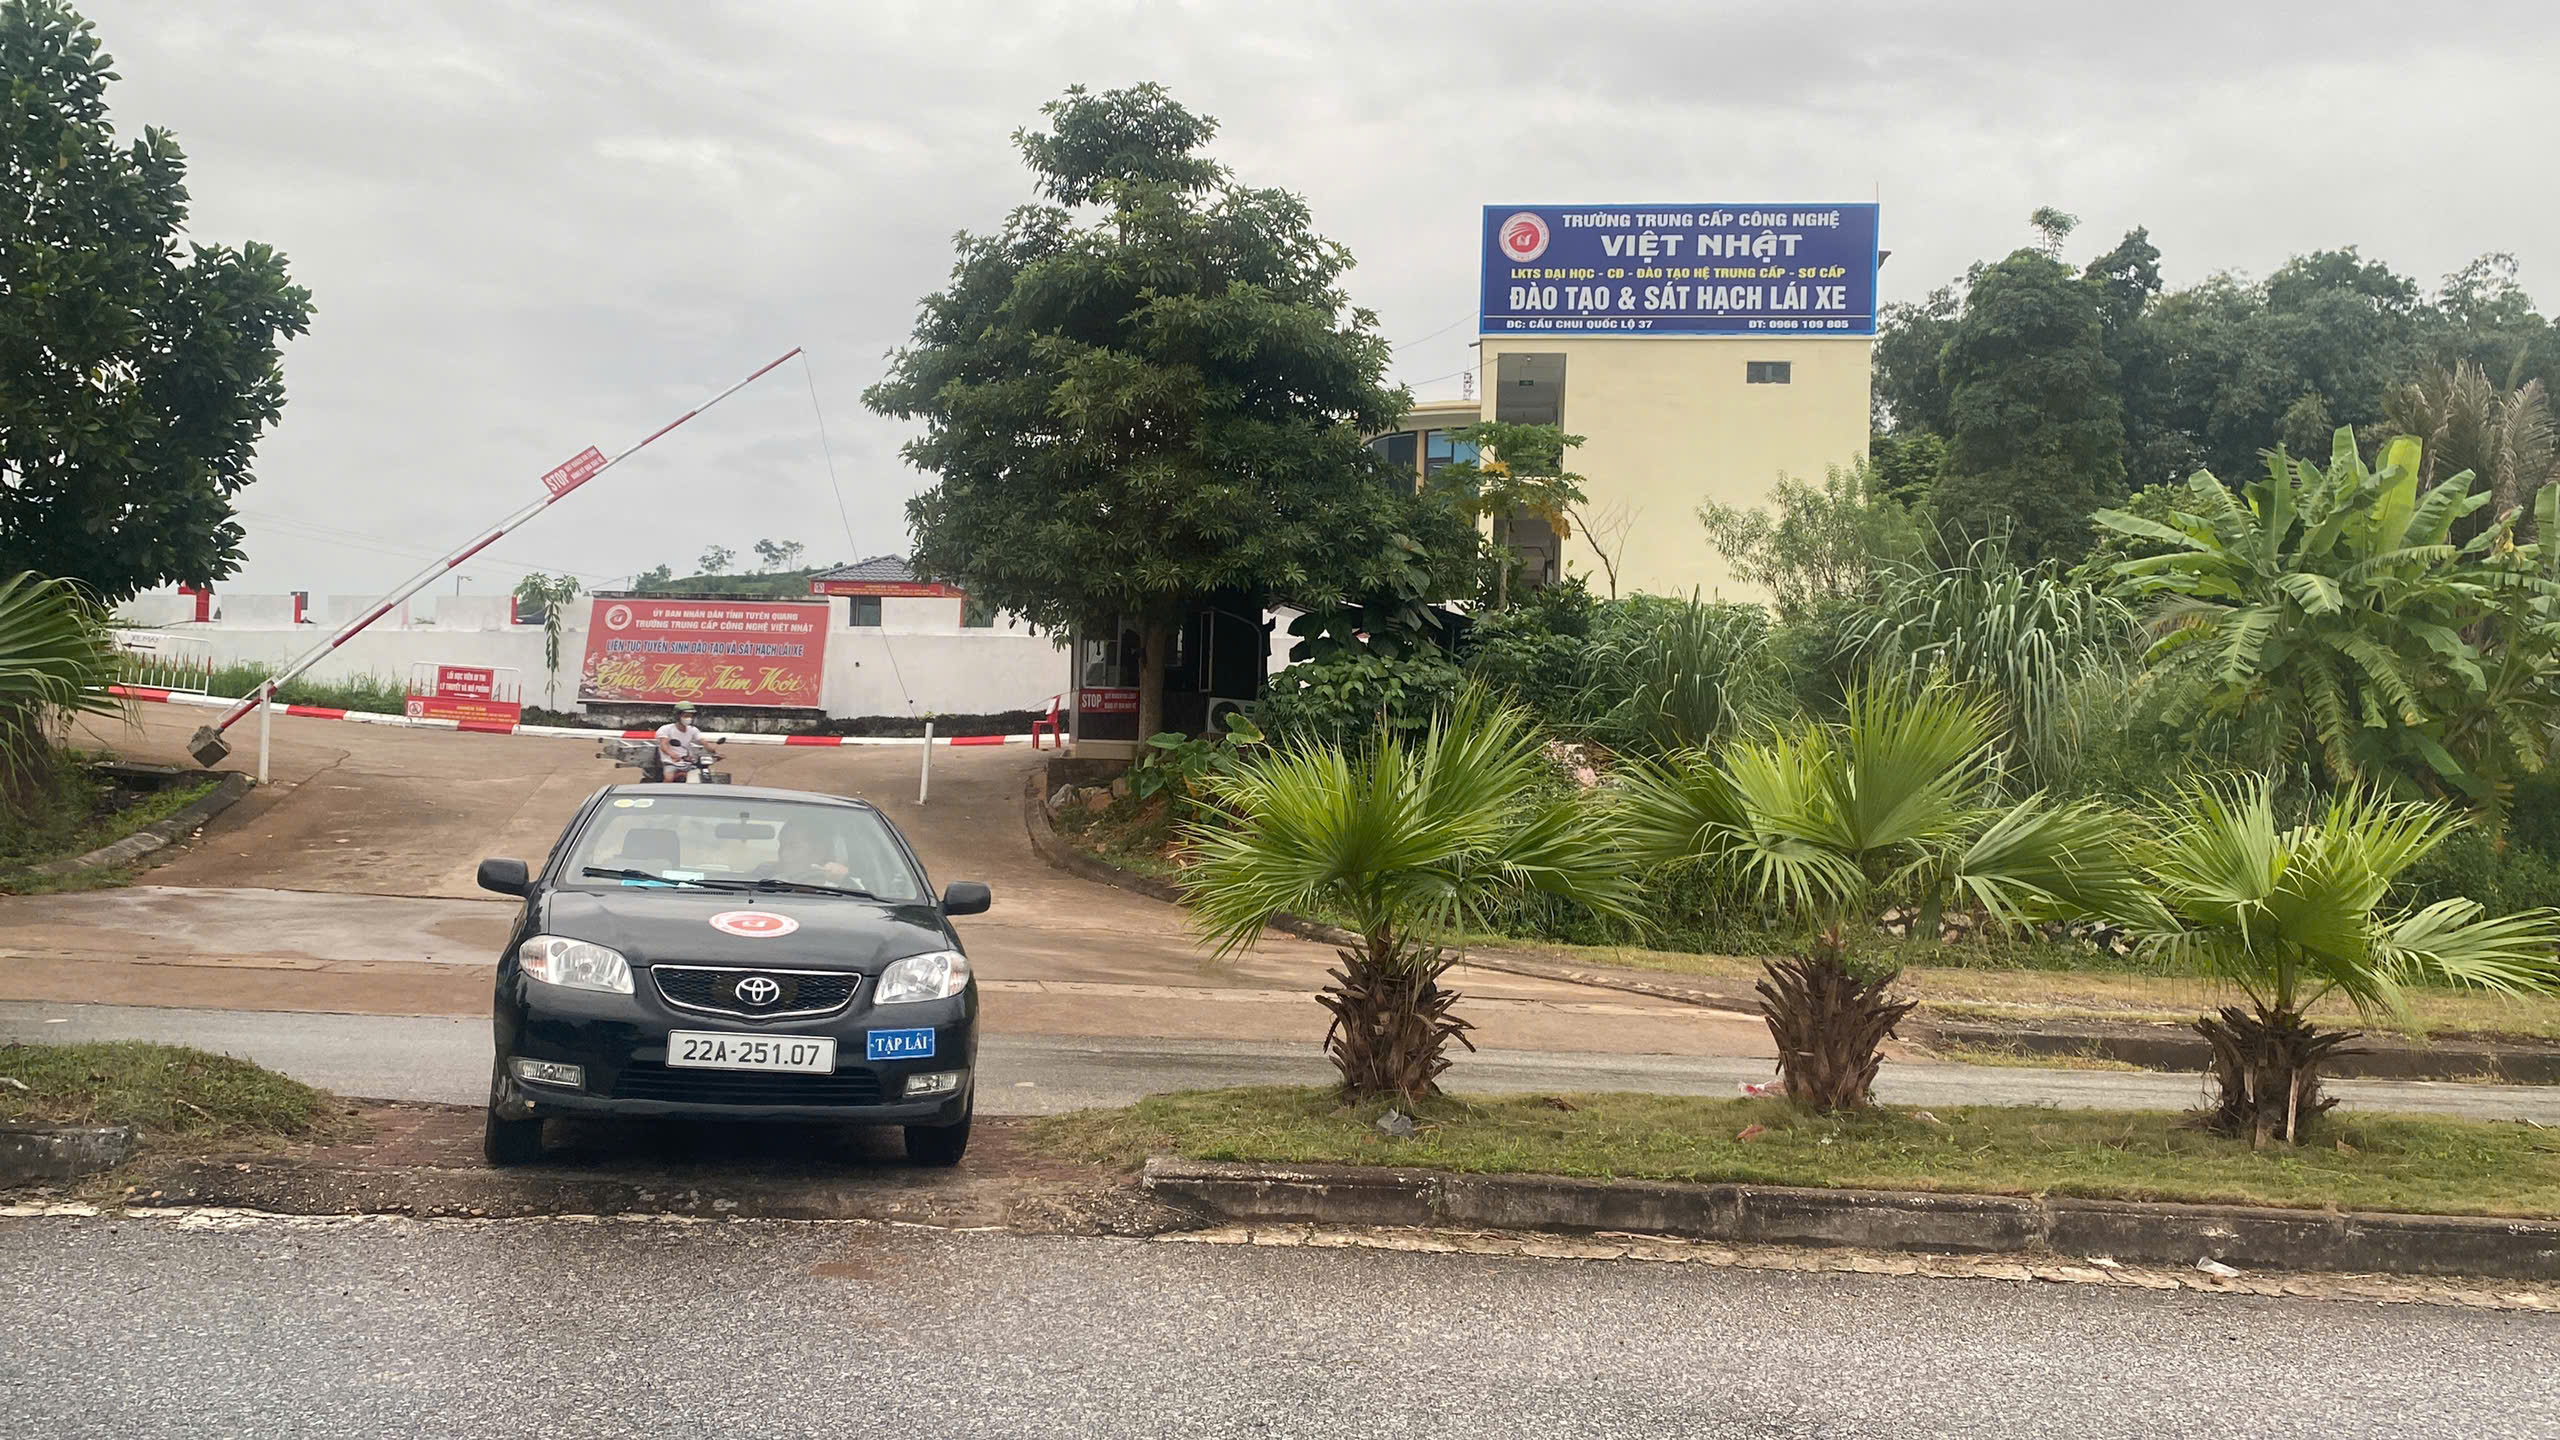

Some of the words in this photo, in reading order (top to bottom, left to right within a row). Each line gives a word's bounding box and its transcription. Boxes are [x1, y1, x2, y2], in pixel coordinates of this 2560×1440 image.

[1562, 211, 1631, 228] TRƯỜNG
[1636, 213, 1693, 227] TRUNG
[1698, 209, 1734, 227] CẤP
[1738, 210, 1788, 227] CÔNG
[1792, 209, 1841, 229] NGHỆ
[1600, 229, 1684, 264] VIỆT
[1697, 229, 1803, 264] NHẬT
[1511, 268, 1542, 279] LKTS
[1569, 268, 1595, 281] HỌC
[1666, 267, 1690, 281] TẠO
[1693, 265, 1711, 281] HỆ
[1713, 267, 1756, 279] TRUNG
[1759, 264, 1786, 279] CẤP
[1798, 267, 1817, 279] SƠ
[1819, 264, 1846, 279] CẤP
[1509, 281, 1559, 311] ĐÀO
[1565, 286, 1610, 315] TẠO
[1618, 286, 1637, 311] &
[1644, 281, 1690, 311] SÁT
[1697, 285, 1763, 315] HẠCH
[1770, 281, 1808, 310] LÁI
[1815, 285, 1847, 310] XE
[1555, 320, 1583, 329] CHUI
[1586, 317, 1618, 330] QUỐC
[1620, 318, 1636, 331] LỘ
[1638, 320, 1654, 329] 37
[1802, 319, 1824, 329] 109
[545, 469, 570, 492] STOP
[671, 620, 699, 630] TRUNG
[720, 621, 744, 631] CÔNG
[670, 642, 690, 654] SINH
[794, 645, 805, 657] XE
[1081, 694, 1102, 708] STOP
[683, 1039, 820, 1066] 22A-251.07
[875, 1036, 903, 1055] TẬP
